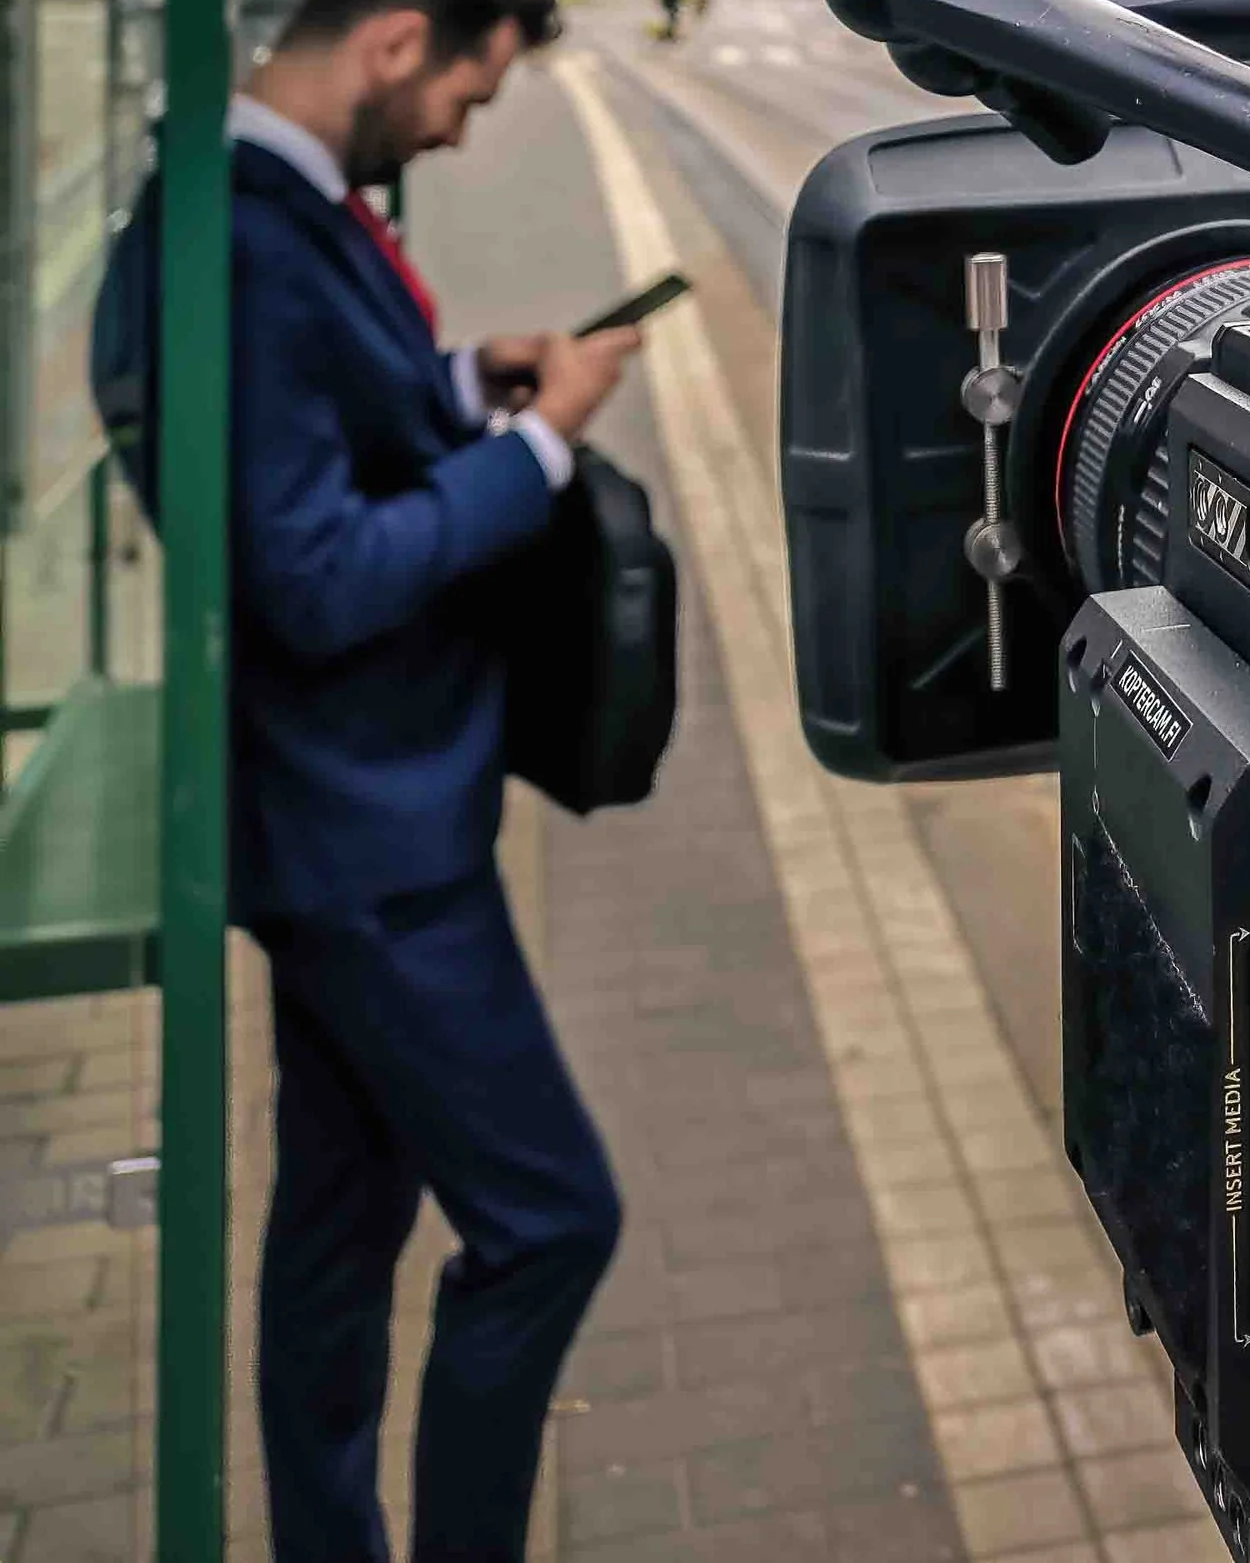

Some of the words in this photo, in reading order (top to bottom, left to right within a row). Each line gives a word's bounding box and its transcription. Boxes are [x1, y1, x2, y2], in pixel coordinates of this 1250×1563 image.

[1117, 665, 1183, 750] KOPTERCAM.FI
[1224, 1067, 1241, 1134] MEDIA
[1226, 1142, 1243, 1214] INSERT
